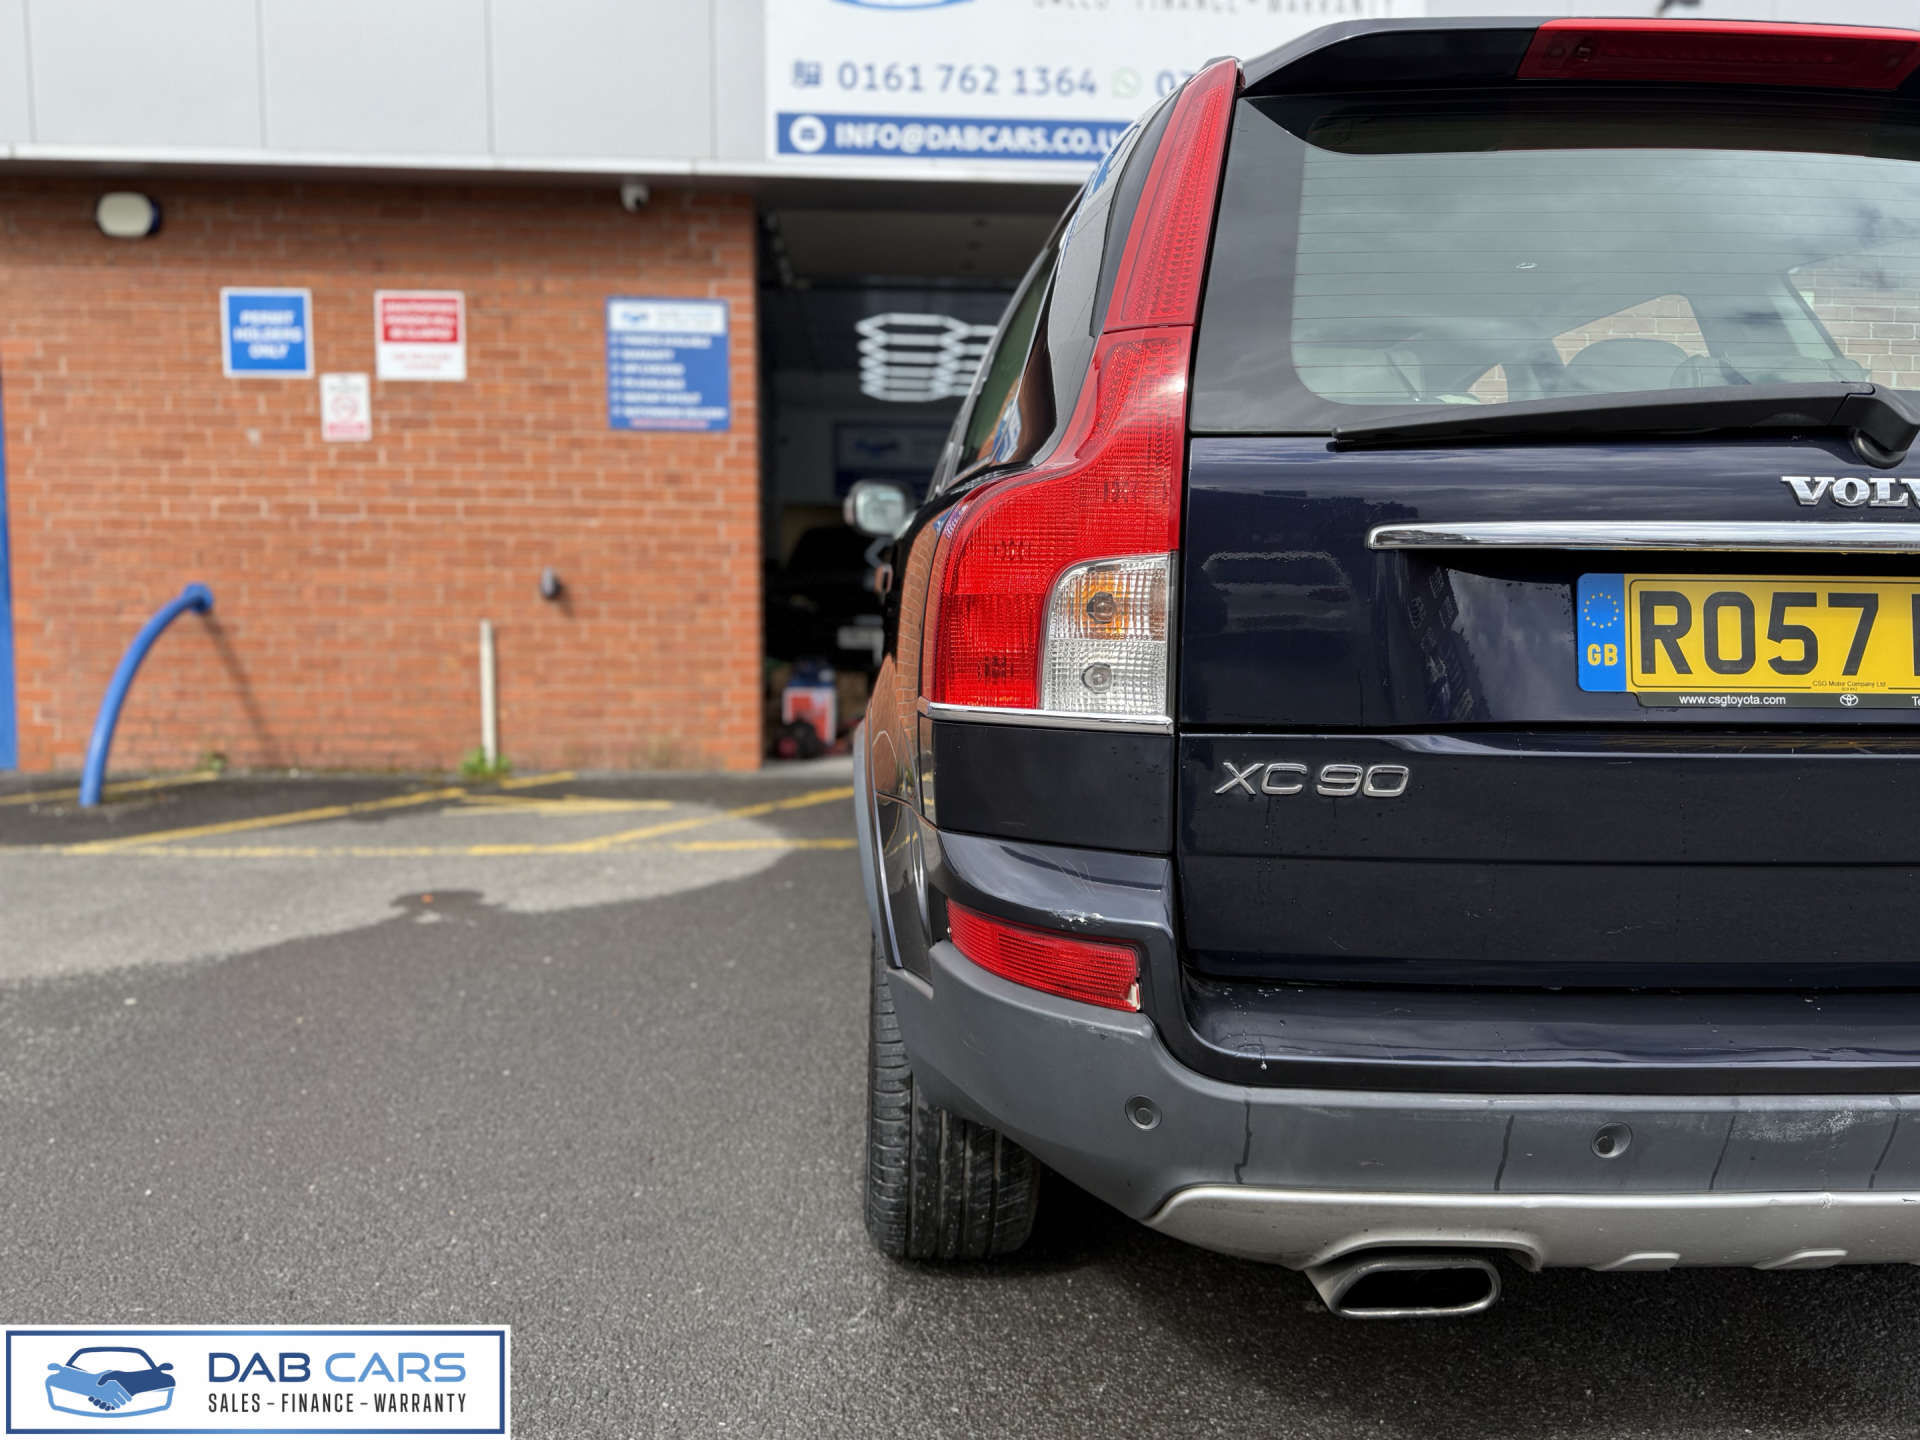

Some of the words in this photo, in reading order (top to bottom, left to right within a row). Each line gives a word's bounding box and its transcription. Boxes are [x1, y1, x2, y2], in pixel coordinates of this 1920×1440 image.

[837, 61, 923, 92] 0161
[936, 64, 1000, 95] 762
[1011, 66, 1097, 98] 1364
[1639, 590, 1880, 677] RO57
[1587, 643, 1619, 667] GB
[1846, 680, 1875, 689] Company
[1678, 694, 1786, 708] www.csgtoyota.com
